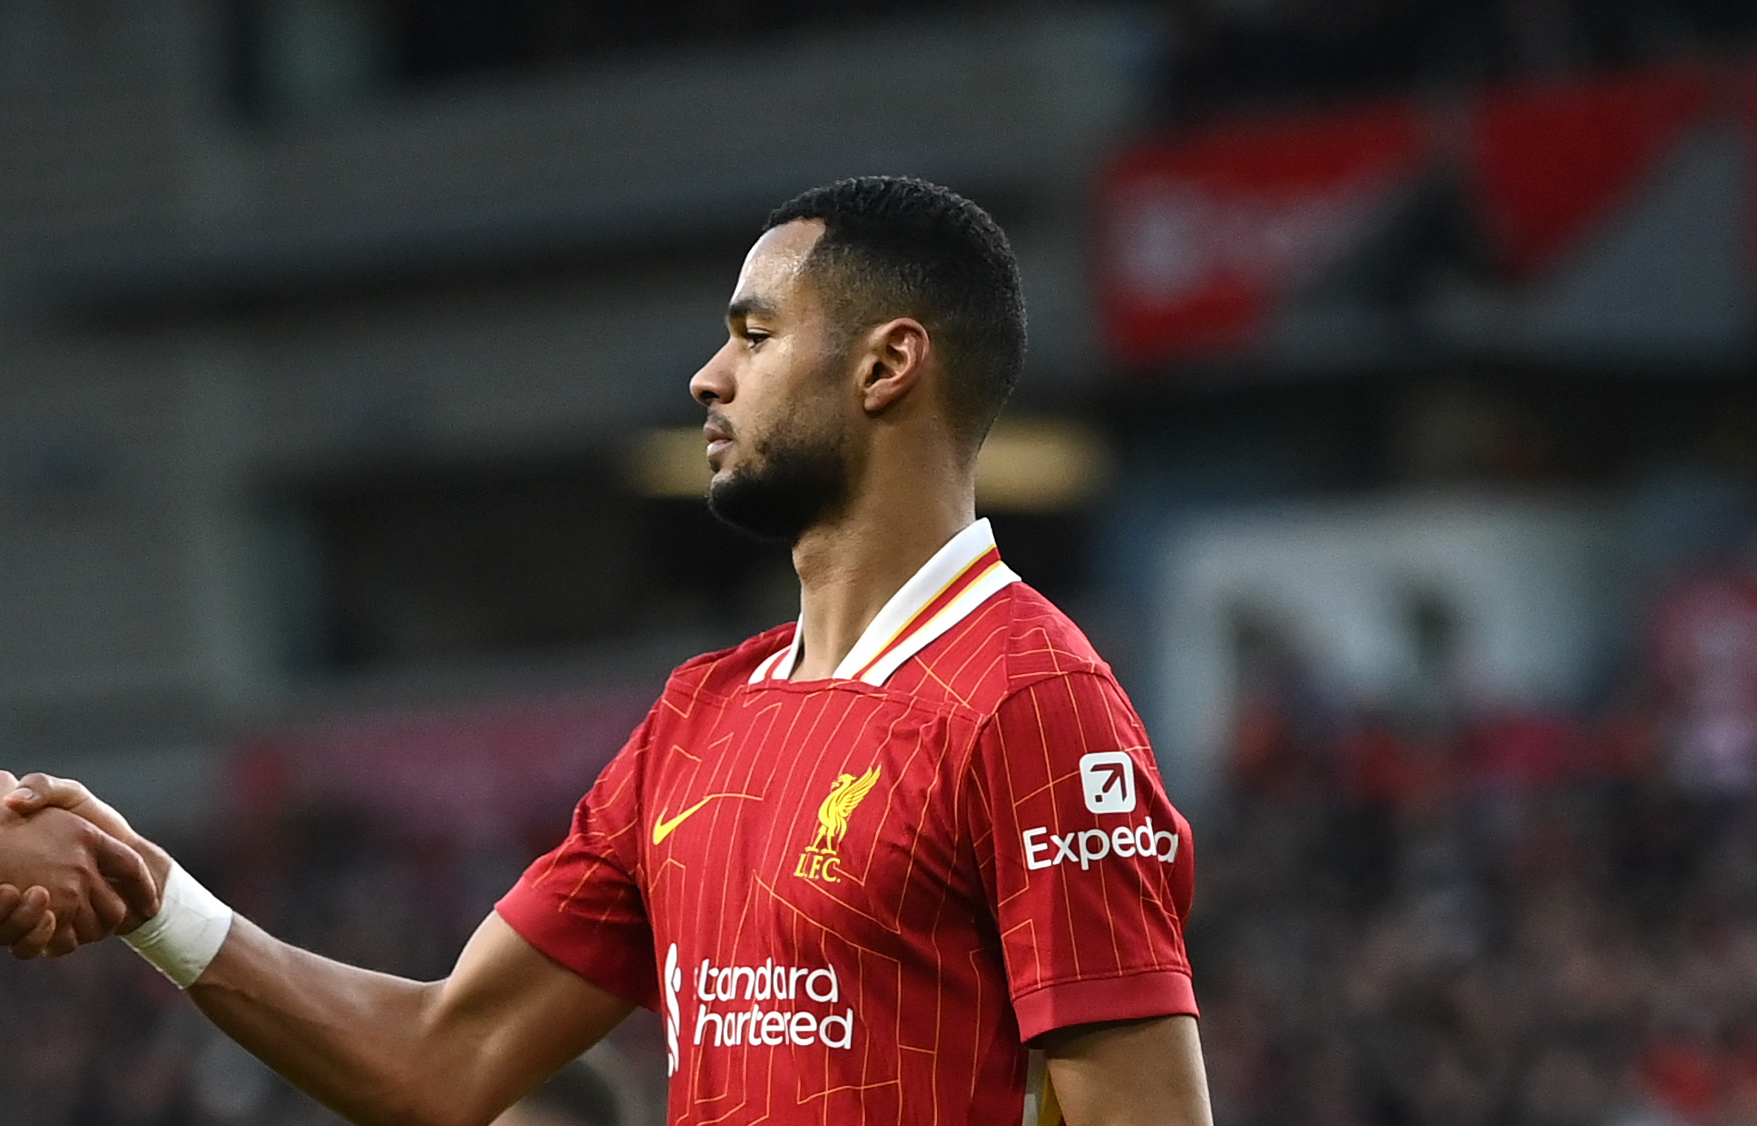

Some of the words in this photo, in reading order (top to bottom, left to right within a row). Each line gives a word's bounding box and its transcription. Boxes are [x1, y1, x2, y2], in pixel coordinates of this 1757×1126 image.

[1022, 816, 1179, 871] Expeda
[694, 957, 839, 1003] tandard
[693, 1003, 854, 1050] hartered
